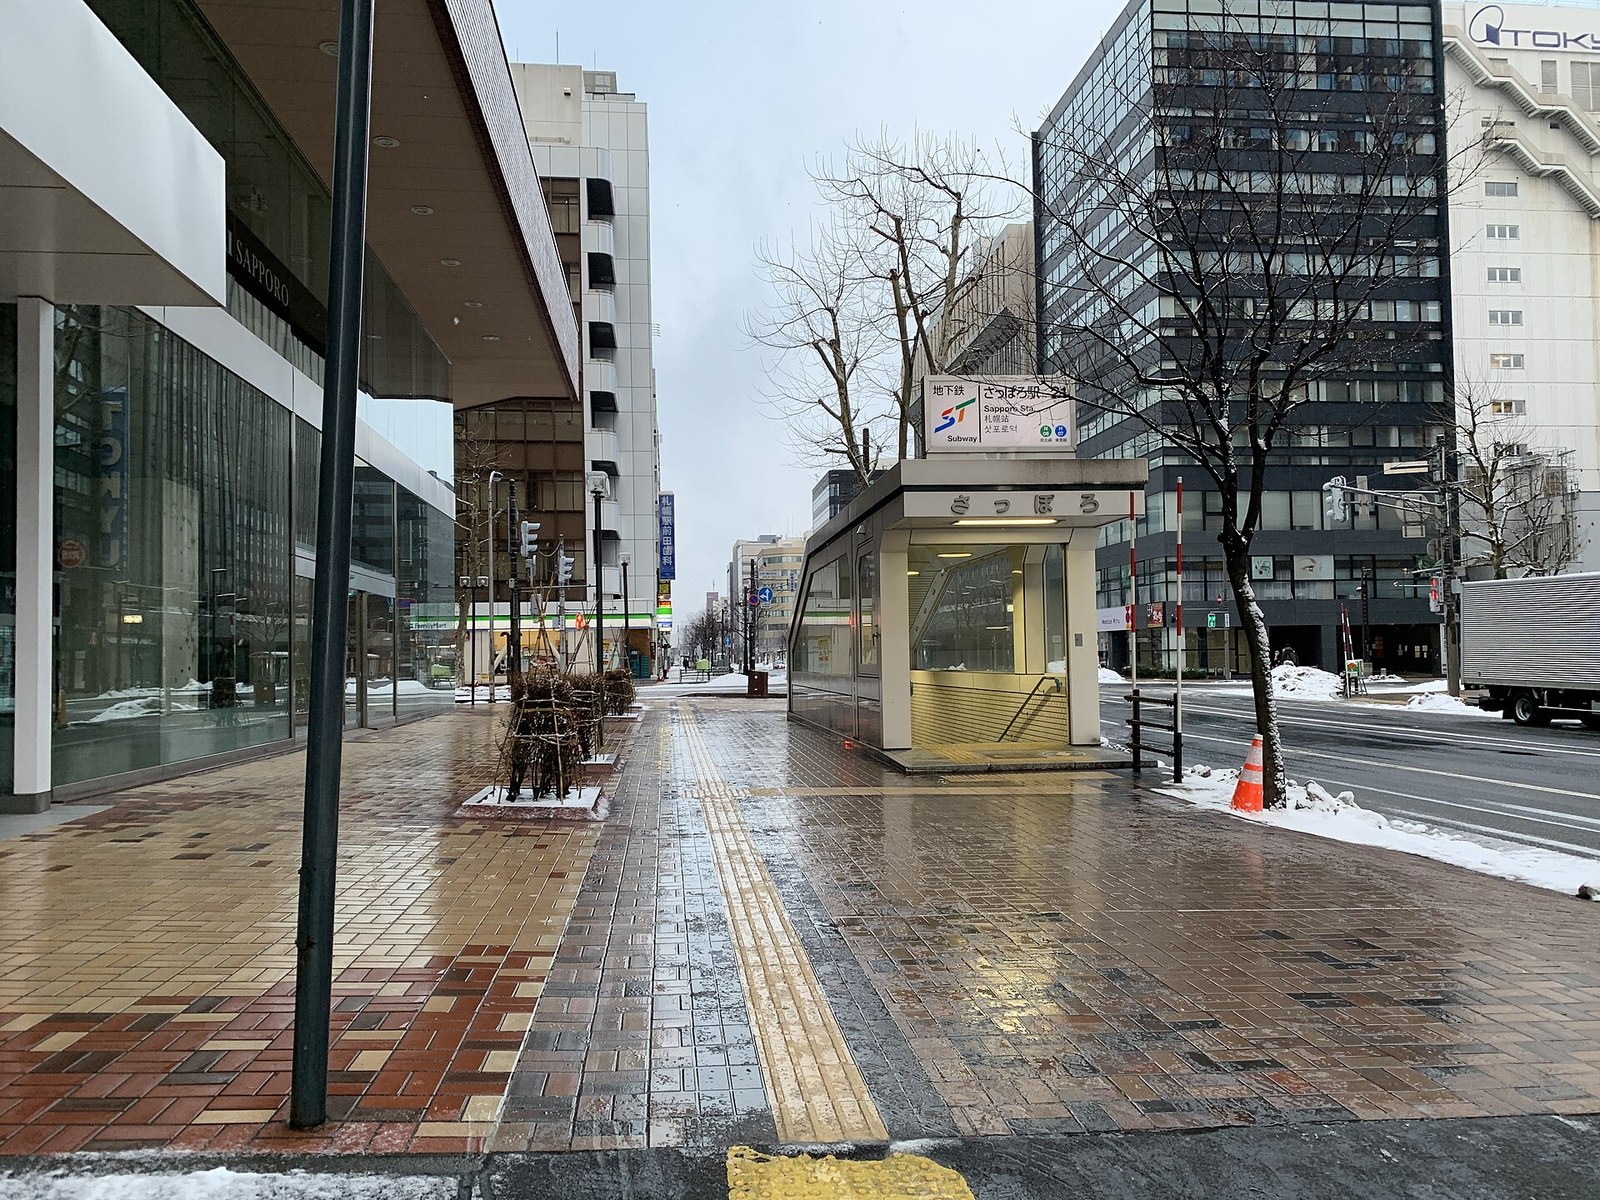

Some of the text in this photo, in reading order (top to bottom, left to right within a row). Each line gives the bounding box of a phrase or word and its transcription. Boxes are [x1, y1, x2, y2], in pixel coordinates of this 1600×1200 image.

[236, 239, 289, 306] SAPPORO
[933, 385, 965, 396] 地下鉄
[984, 385, 1040, 399] さっぽろ駅
[984, 405, 1018, 413] Sapporo
[947, 435, 977, 443] Subway
[951, 494, 1099, 514] さっぽろ
